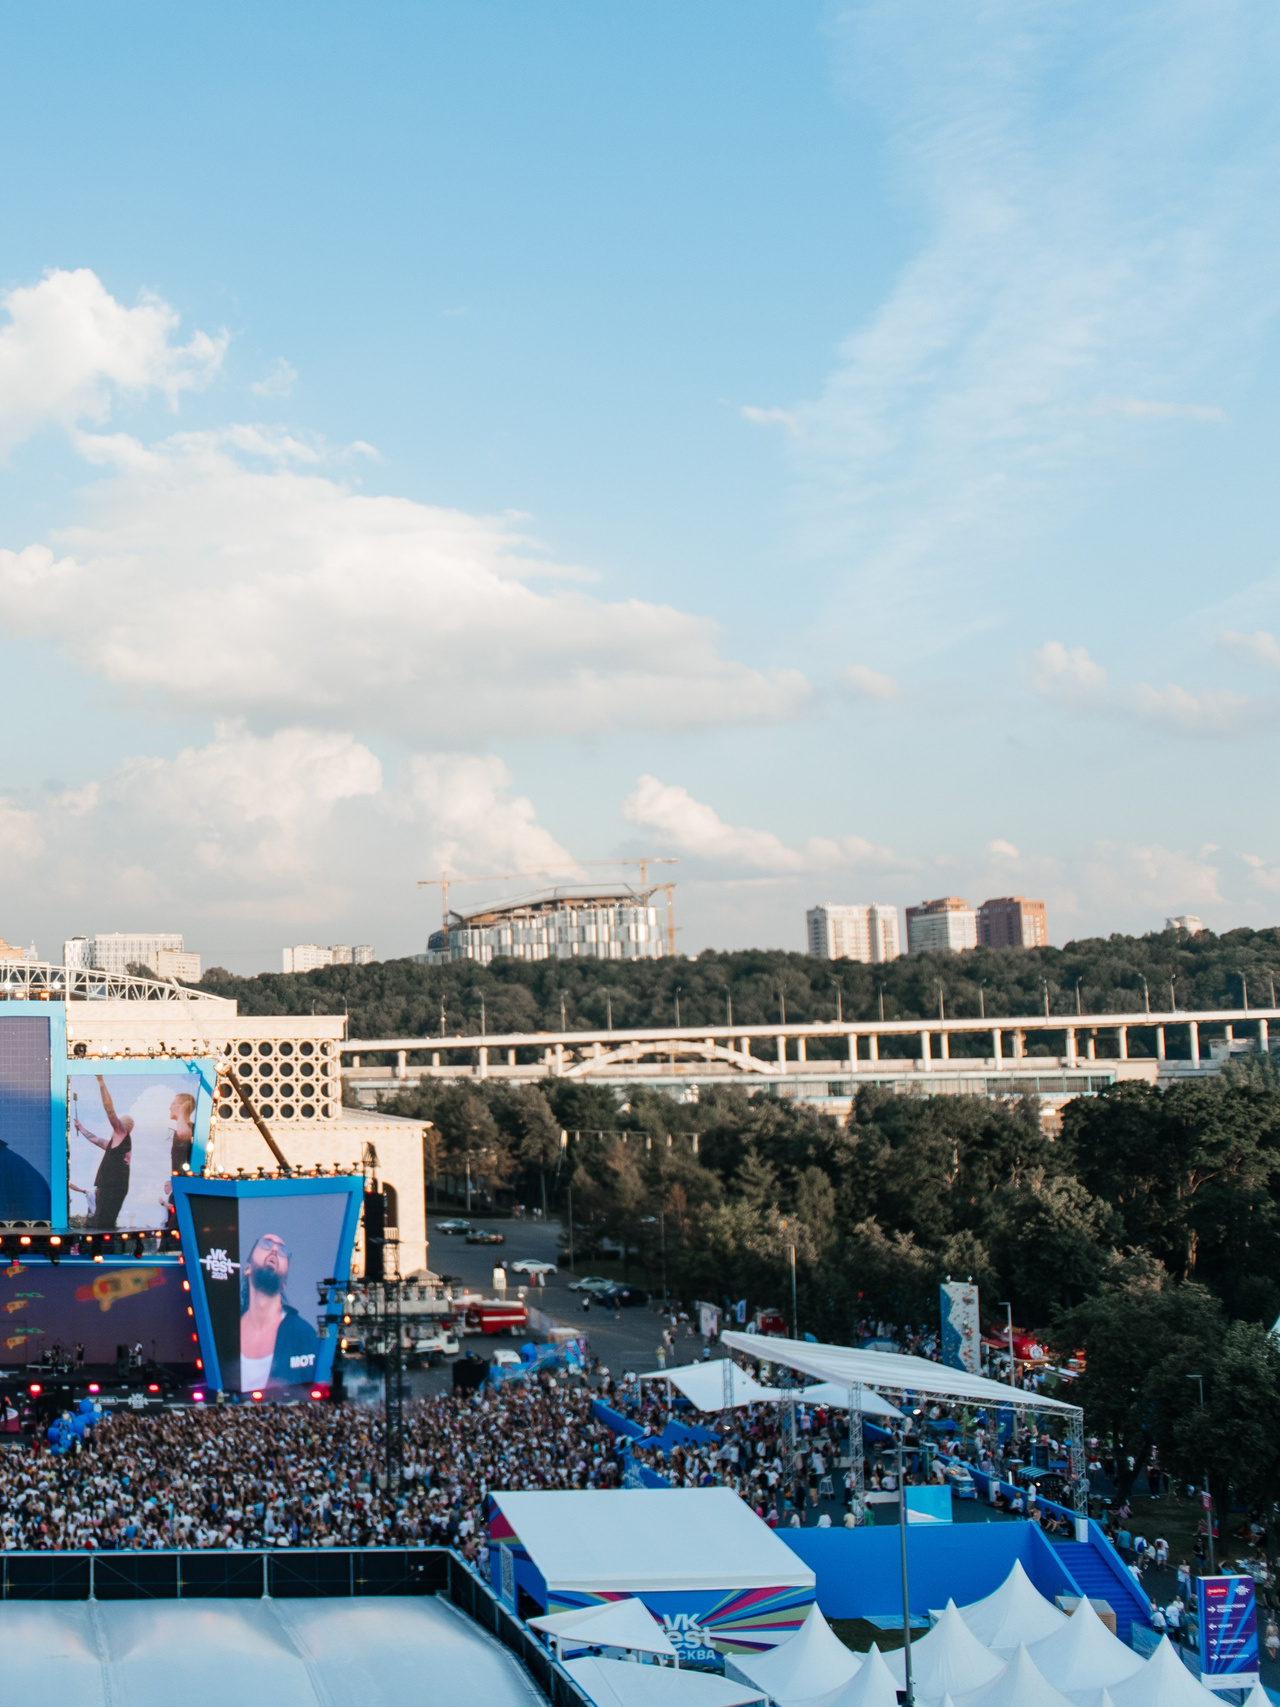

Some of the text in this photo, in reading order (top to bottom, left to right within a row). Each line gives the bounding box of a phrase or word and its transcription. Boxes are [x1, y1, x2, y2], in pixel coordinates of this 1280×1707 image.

[210, 1248, 227, 1261] VK
[205, 1255, 234, 1274] fest
[663, 1613, 701, 1631] VK
[662, 1627, 716, 1649] est
